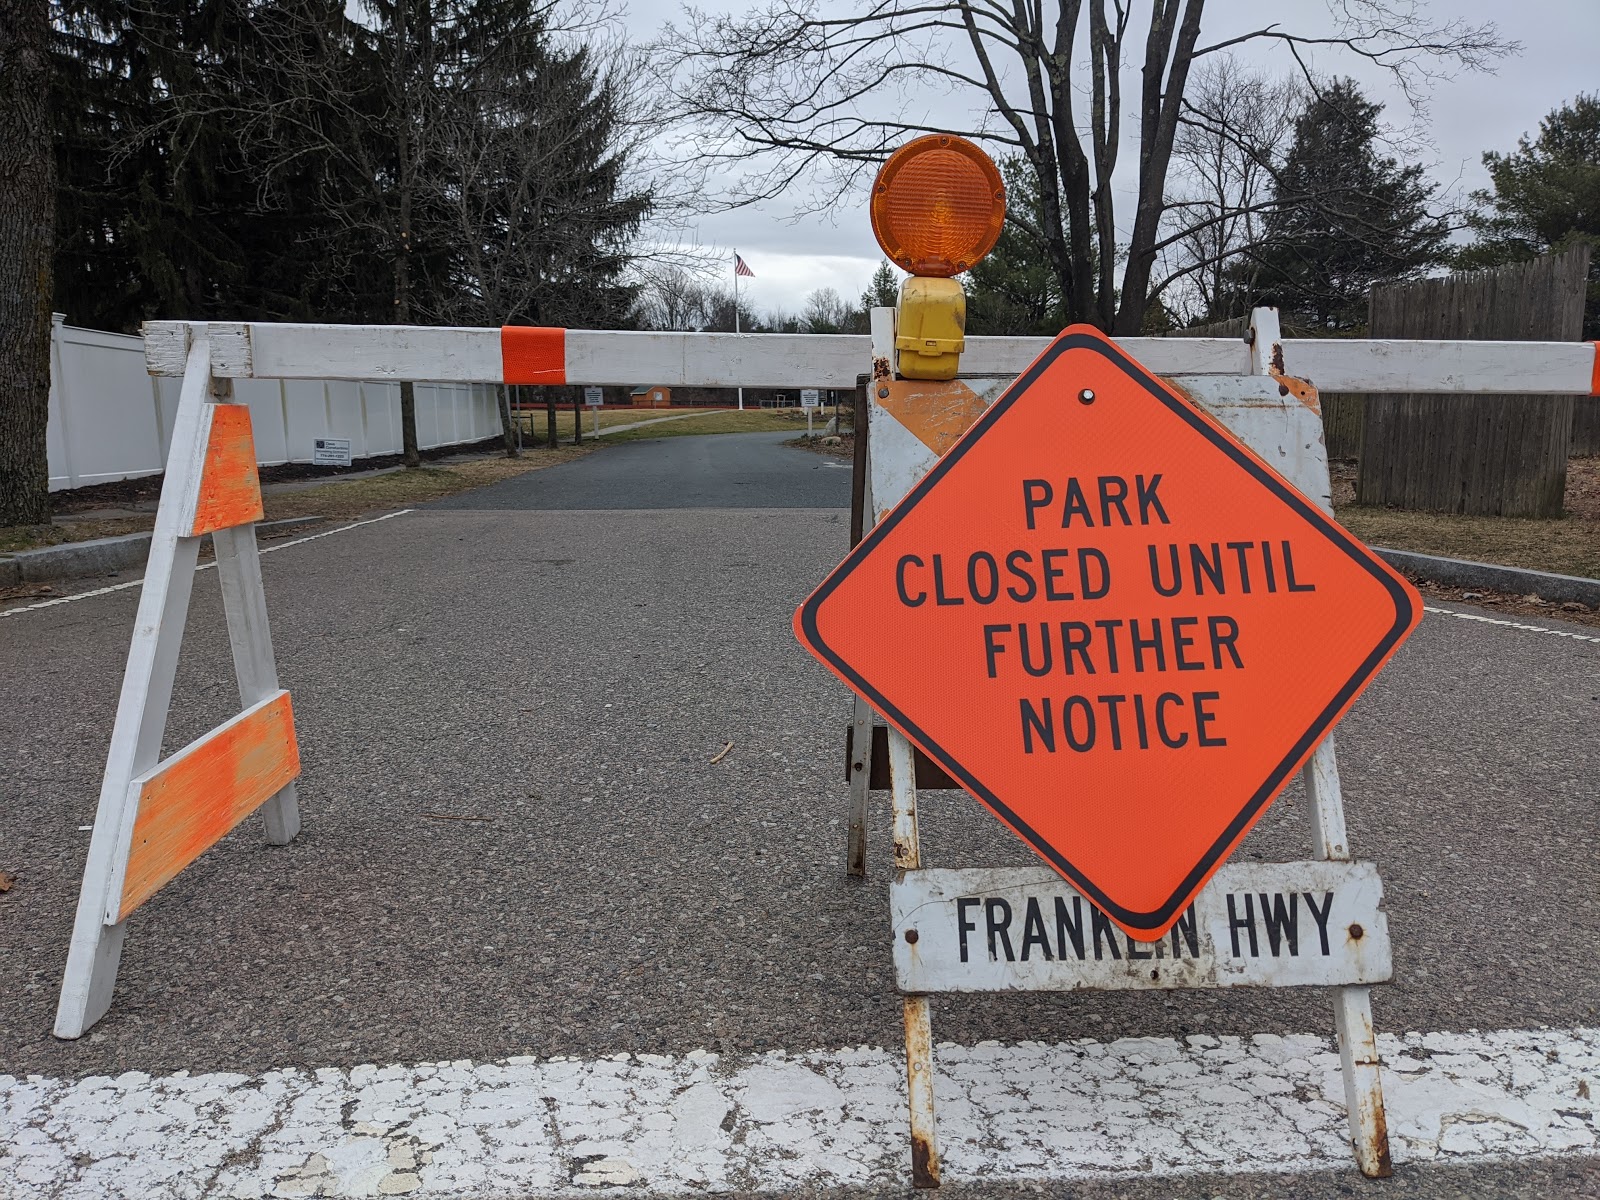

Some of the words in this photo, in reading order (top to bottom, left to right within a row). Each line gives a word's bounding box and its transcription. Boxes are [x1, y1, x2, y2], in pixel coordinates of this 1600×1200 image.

[1023, 474, 1170, 529] PARK
[895, 548, 1110, 607] CLOSED
[1148, 541, 1315, 597] UNTIL
[984, 616, 1244, 678] FURTHER
[1020, 692, 1226, 753] NOTICE
[1226, 892, 1334, 958] HWY
